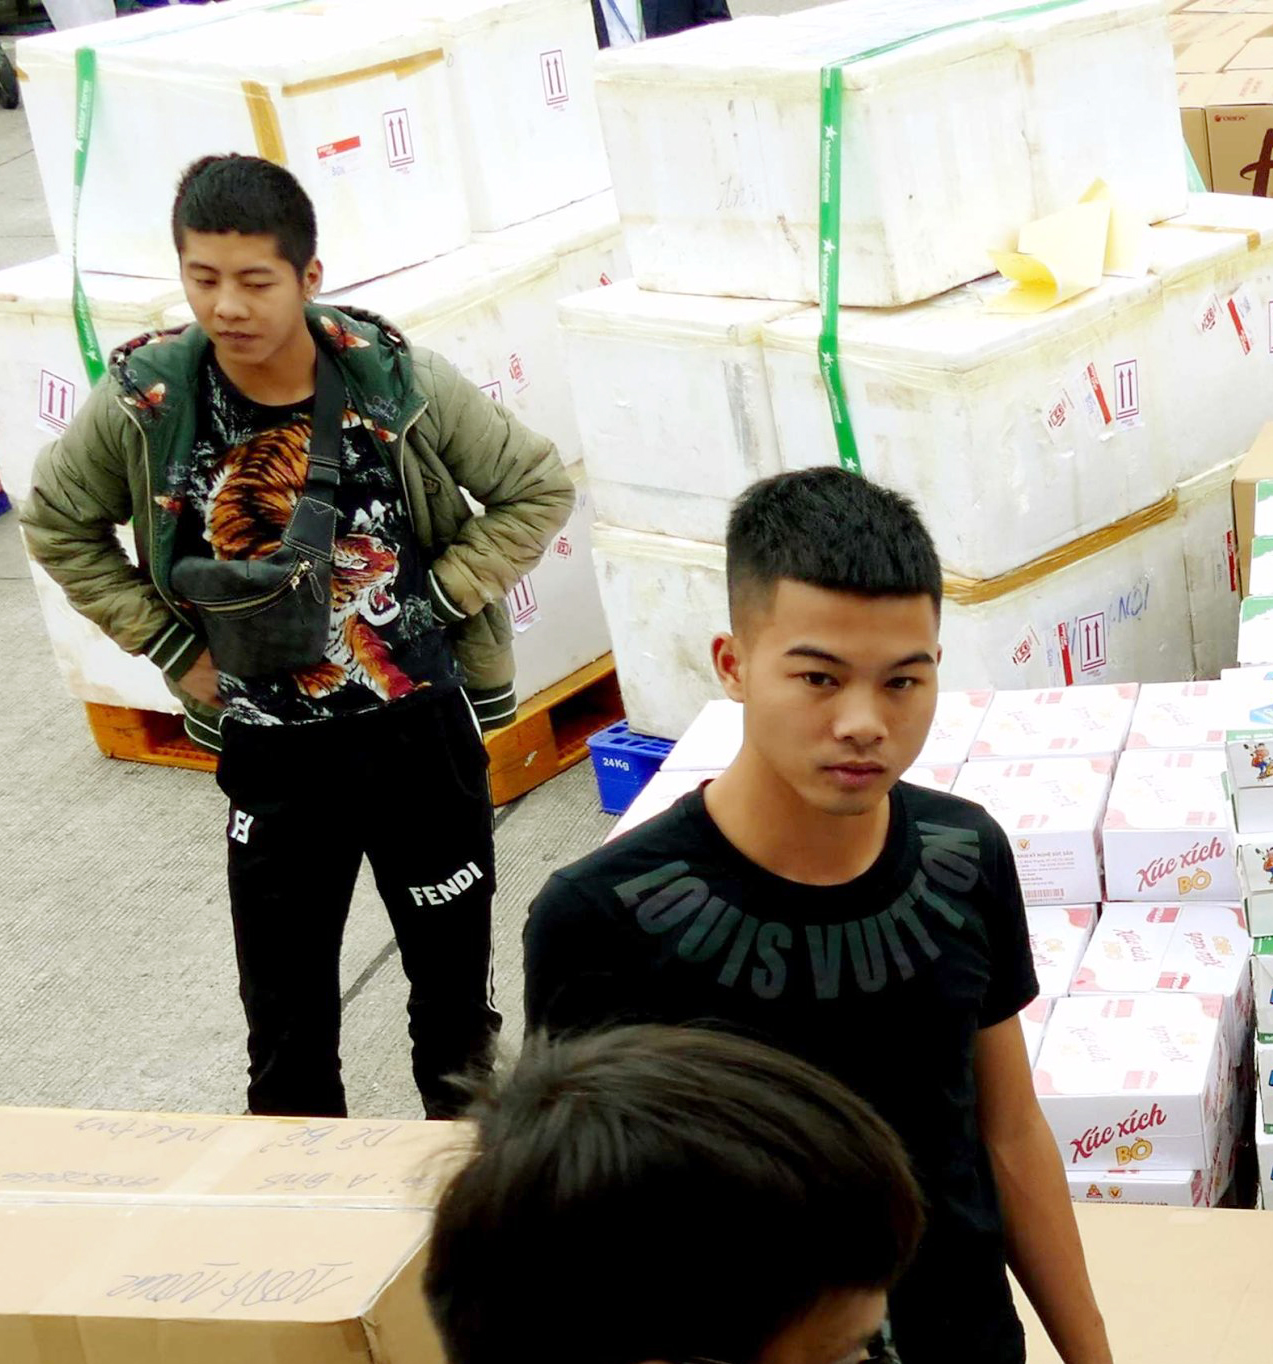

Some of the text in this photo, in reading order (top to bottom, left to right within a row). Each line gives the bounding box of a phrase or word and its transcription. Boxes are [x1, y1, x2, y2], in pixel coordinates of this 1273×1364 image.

[409, 860, 485, 911] FENDI
[1136, 837, 1225, 892] Xúc xích
[1177, 868, 1212, 896] BÒ
[613, 822, 981, 1000] LOUIS VUITTON
[1070, 1103, 1167, 1164] Xúc xích
[1115, 1137, 1153, 1166] BÒ
